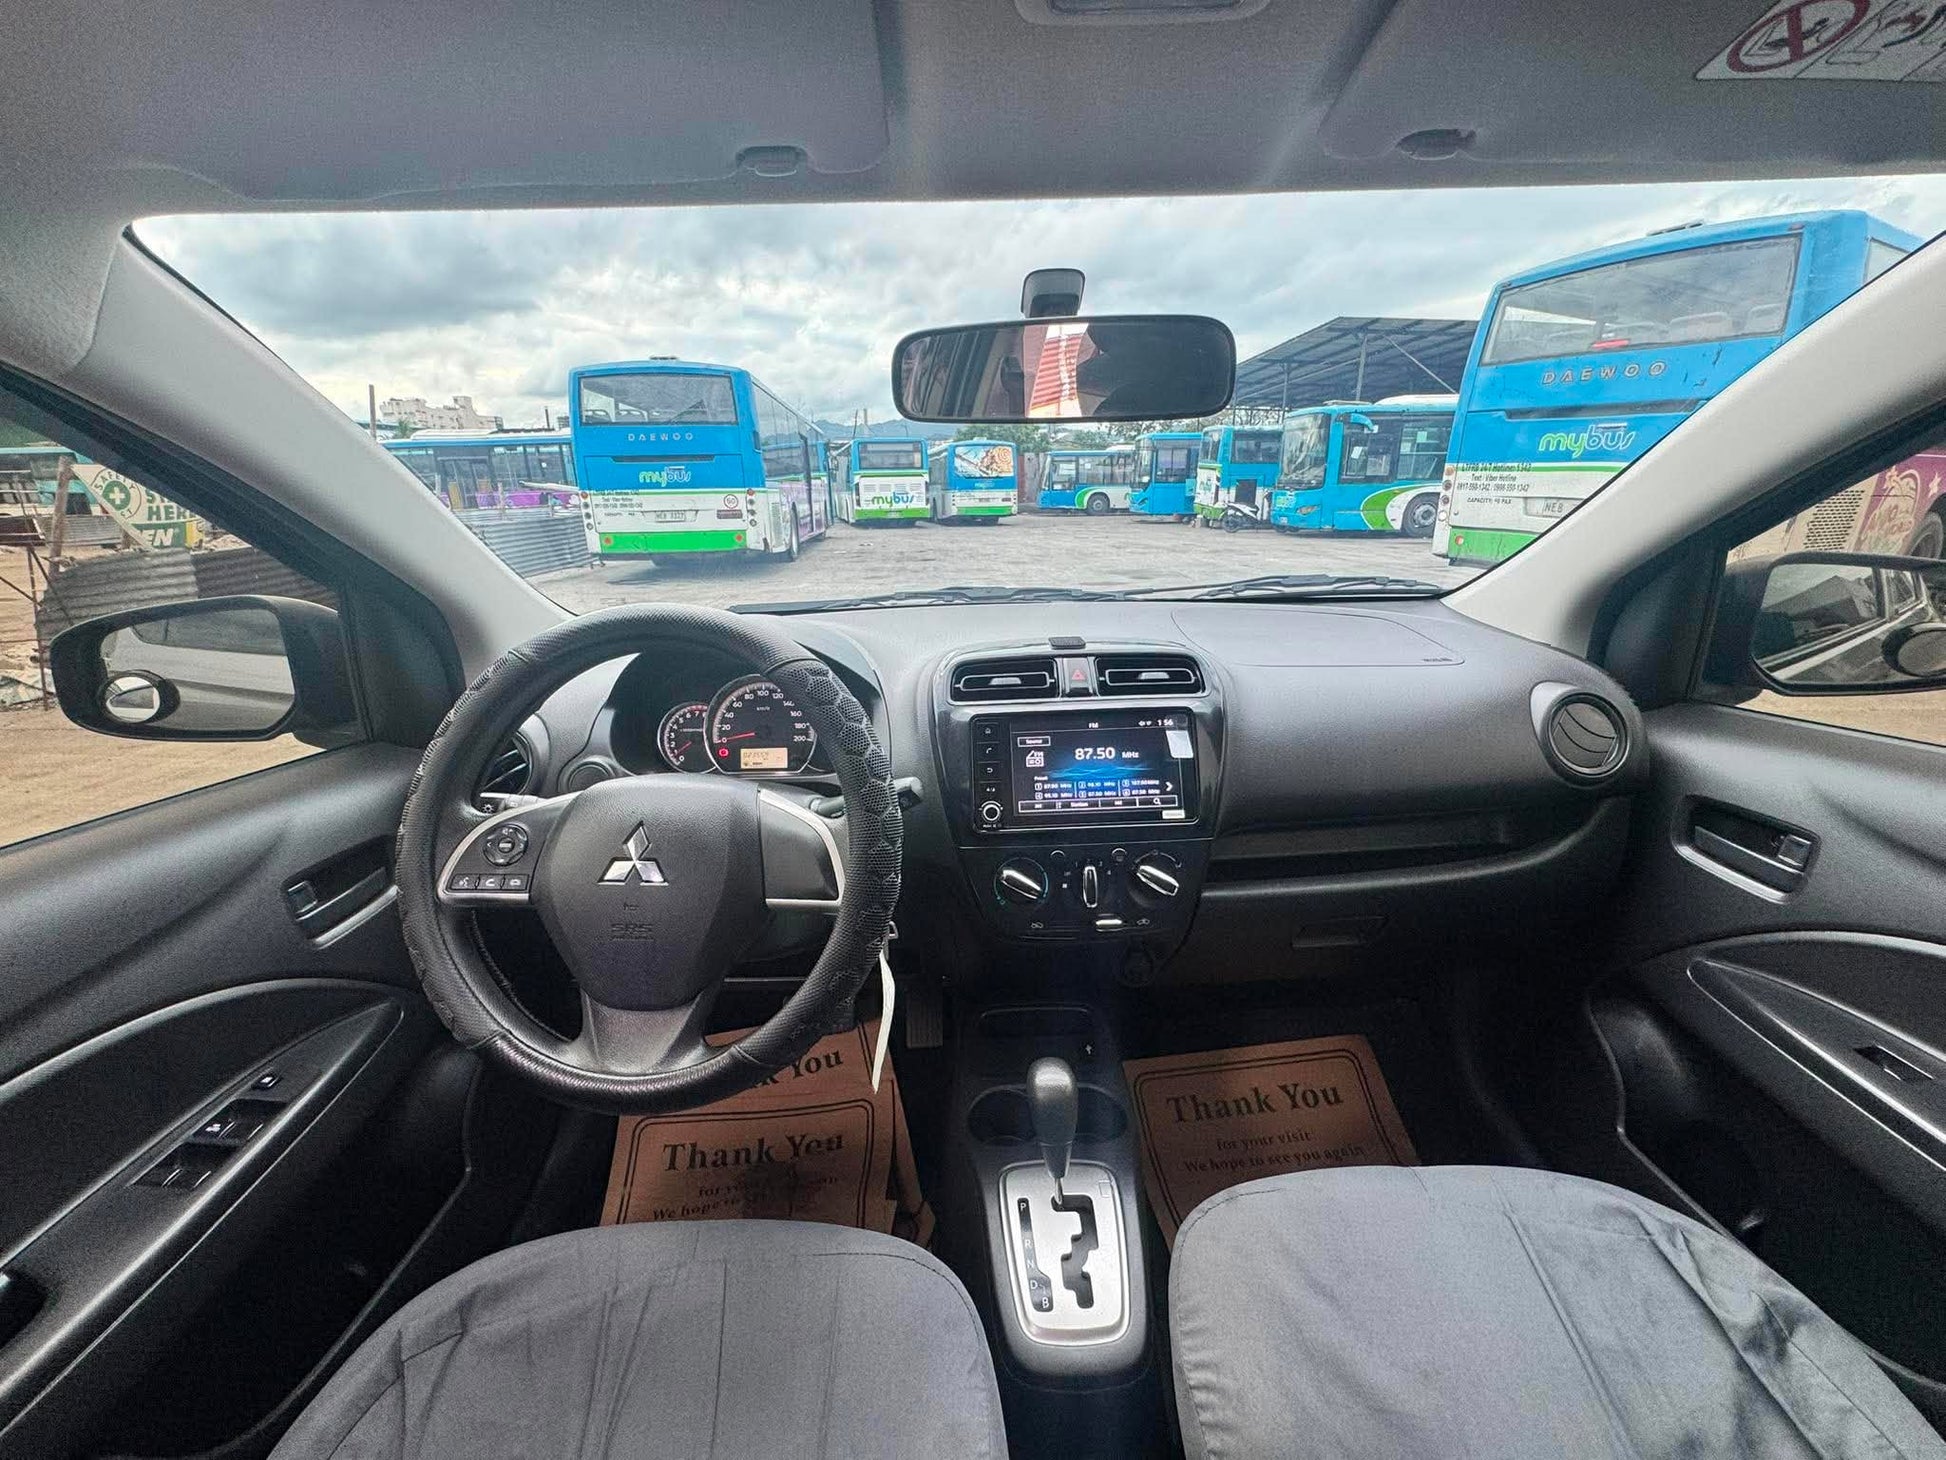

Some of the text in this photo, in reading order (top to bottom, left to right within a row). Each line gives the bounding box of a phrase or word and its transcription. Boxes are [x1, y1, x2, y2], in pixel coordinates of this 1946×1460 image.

[1542, 360, 1668, 385] DAEWOO
[627, 432, 694, 442] DAEWOO
[1538, 423, 1636, 459] mybus
[638, 466, 692, 487] mybus
[871, 491, 914, 507] mybus
[725, 711, 734, 719] 40
[1075, 747, 1116, 760] 87.50
[1166, 1082, 1345, 1123] Thank You
[1242, 1136, 1274, 1149] your
[1278, 1130, 1312, 1143] visit
[663, 1133, 845, 1172] Thank You
[1184, 1145, 1366, 1172] We hope to see you again
[1020, 1203, 1027, 1211] P
[1024, 1240, 1032, 1248] R
[1027, 1260, 1035, 1269] N
[1030, 1280, 1038, 1290] D
[1042, 1297, 1049, 1309] B
